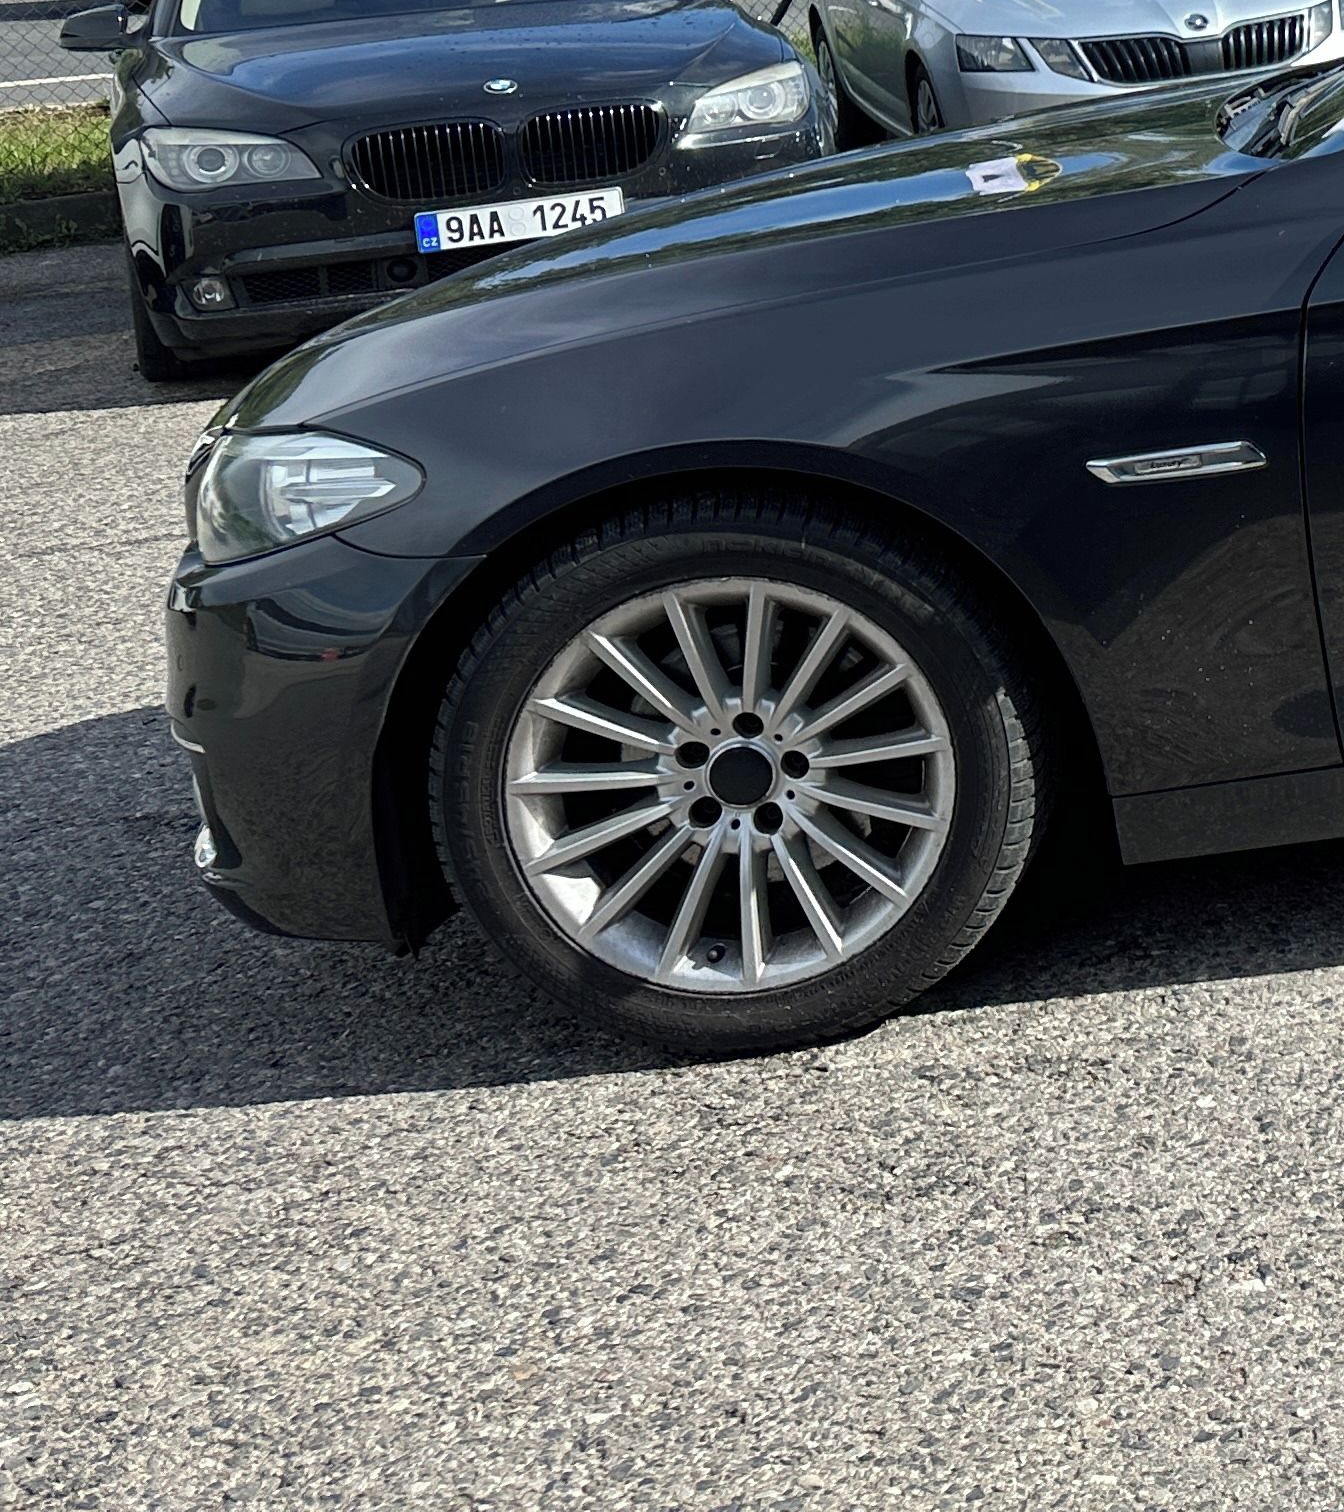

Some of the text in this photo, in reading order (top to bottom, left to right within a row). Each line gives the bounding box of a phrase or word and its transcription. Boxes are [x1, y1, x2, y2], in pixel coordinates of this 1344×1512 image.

[445, 196, 607, 243] 9AA 1245
[422, 237, 439, 248] CZ
